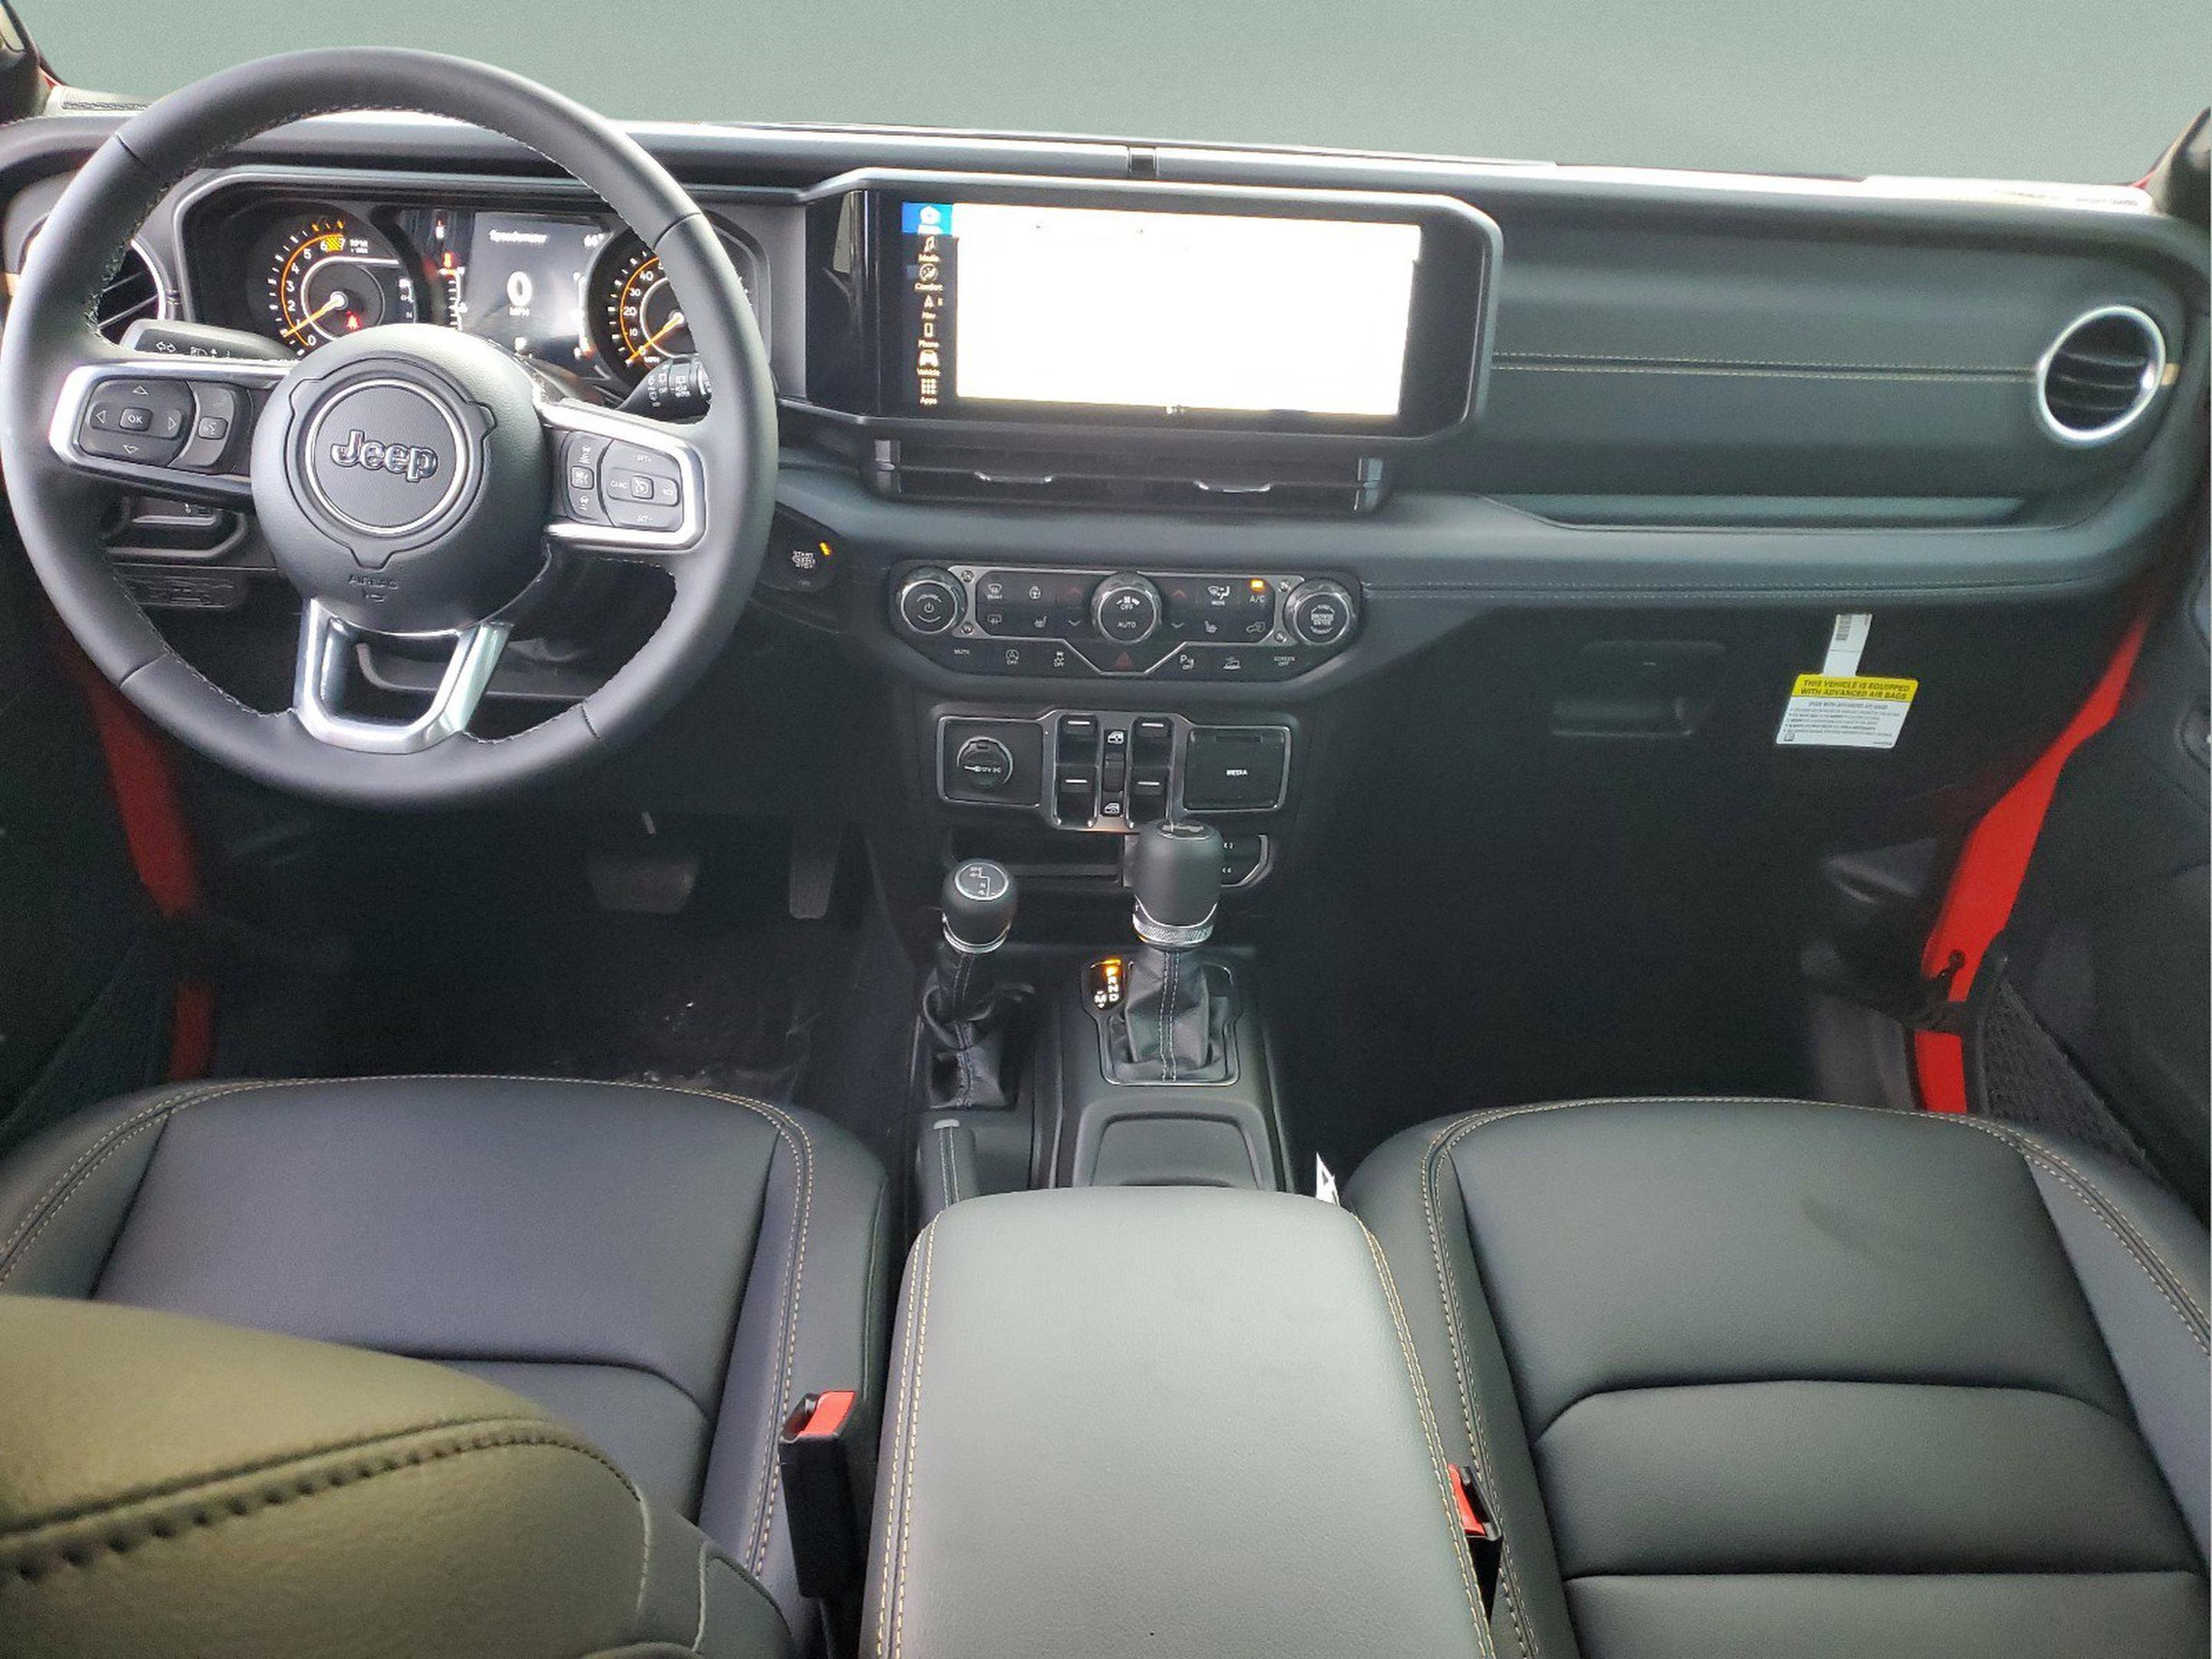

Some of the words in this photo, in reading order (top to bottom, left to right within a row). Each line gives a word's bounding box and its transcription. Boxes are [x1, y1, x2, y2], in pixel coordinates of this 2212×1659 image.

[303, 248, 313, 260] 5
[291, 262, 300, 274] 4
[639, 271, 654, 282] 40
[286, 280, 295, 293] 3
[507, 271, 533, 306] 0
[629, 287, 641, 297] 30
[286, 300, 296, 312] 2
[623, 306, 637, 316] 20
[628, 328, 638, 337] 10
[307, 335, 316, 346] 0
[127, 413, 143, 425] OK
[330, 429, 439, 483] Jeep
[1249, 594, 1266, 604] A/C
[1804, 679, 1822, 687] THIS
[1824, 680, 1857, 689] VEHICLE
[1868, 683, 1910, 692] EQUIPPED
[1823, 689, 1867, 697] ADVANCED
